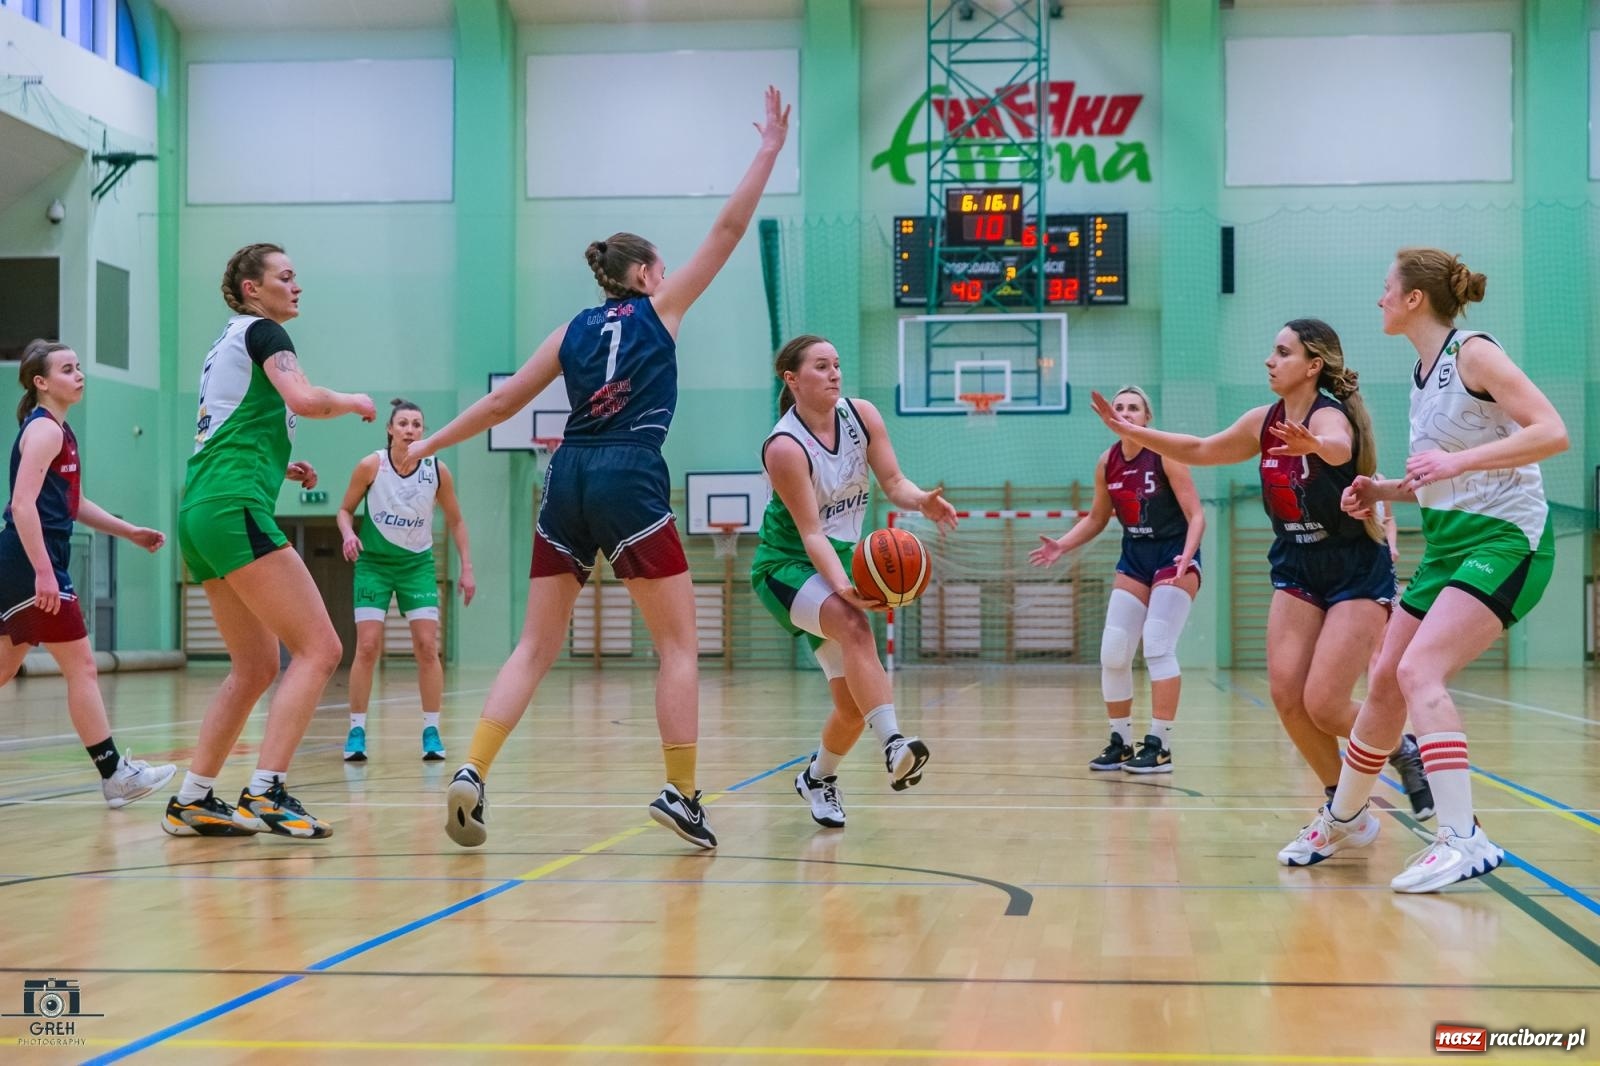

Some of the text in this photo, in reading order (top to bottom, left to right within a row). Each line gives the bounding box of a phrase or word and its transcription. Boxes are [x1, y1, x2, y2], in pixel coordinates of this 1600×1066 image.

[975, 214, 1004, 241] 10
[952, 279, 983, 302] 40
[1048, 279, 1079, 301] 32
[600, 320, 621, 382] 7
[1144, 471, 1156, 493] 5
[385, 514, 424, 527] Clavis
